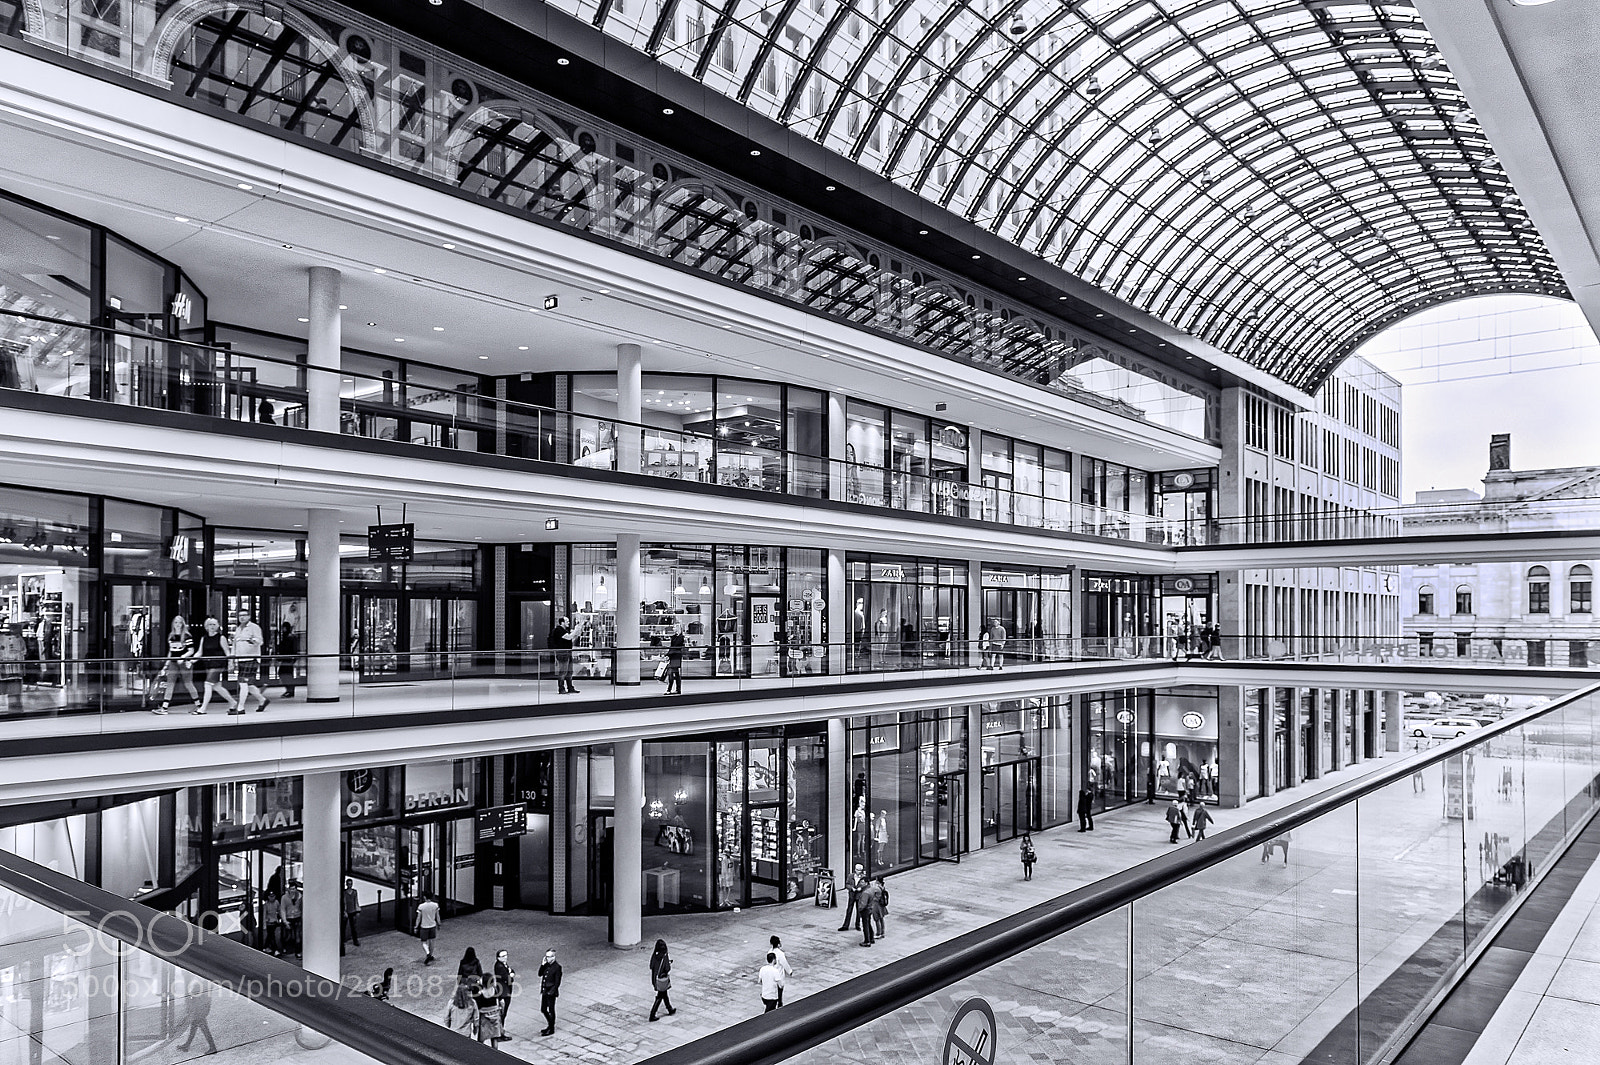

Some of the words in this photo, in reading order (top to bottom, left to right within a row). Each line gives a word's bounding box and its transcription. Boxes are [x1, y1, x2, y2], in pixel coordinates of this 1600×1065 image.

[881, 568, 905, 578] ZARA
[988, 574, 1009, 583] ZARA
[521, 790, 537, 800] 130
[250, 809, 304, 832] MAL
[346, 799, 375, 819] OF
[405, 787, 470, 811] BERLIN
